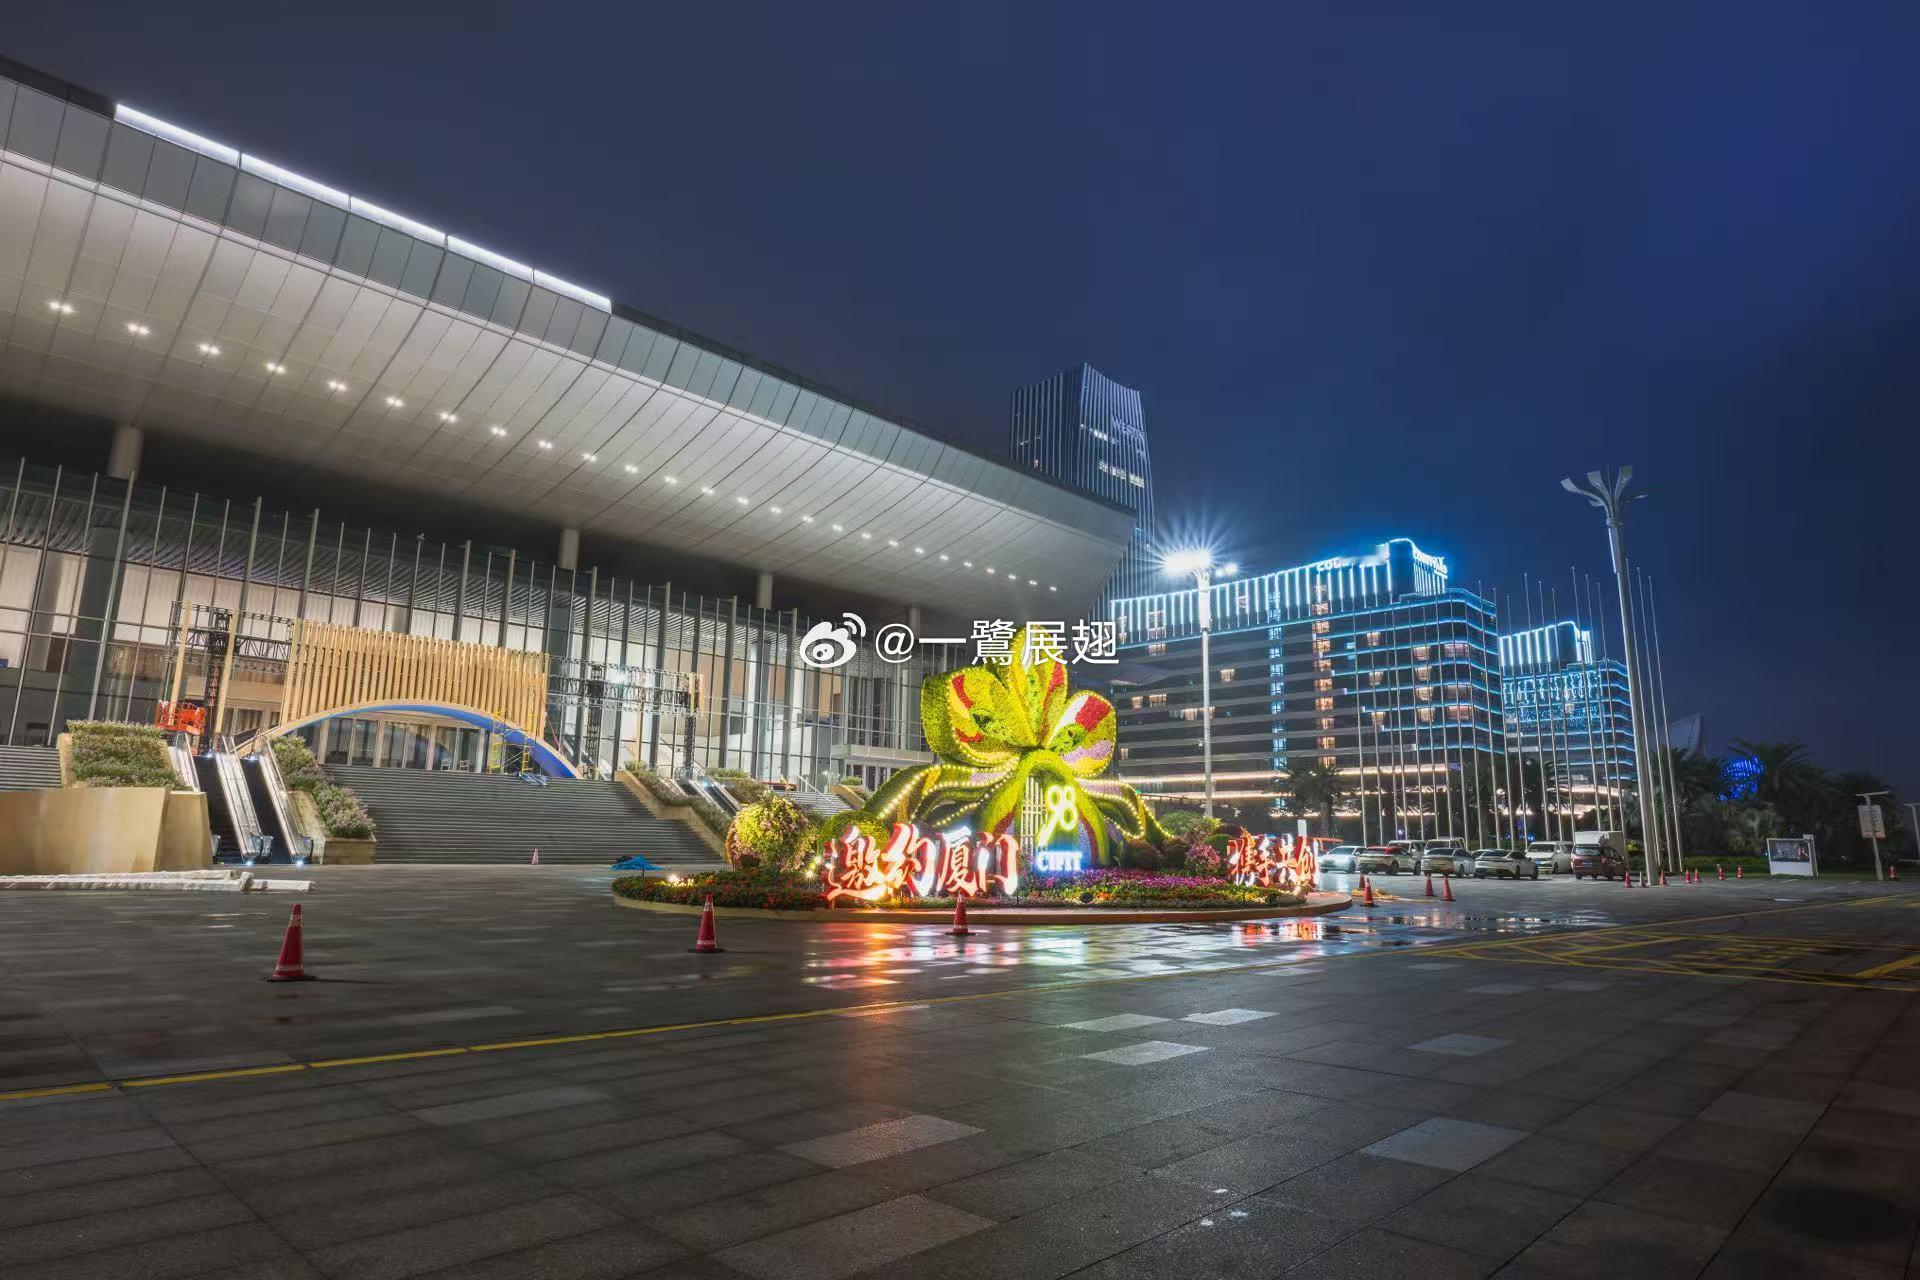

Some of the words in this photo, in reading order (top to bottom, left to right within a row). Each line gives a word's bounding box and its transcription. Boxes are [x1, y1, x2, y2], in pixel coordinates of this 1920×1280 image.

[1037, 785, 1078, 847] 98
[822, 823, 1020, 900] 邀约厦门
